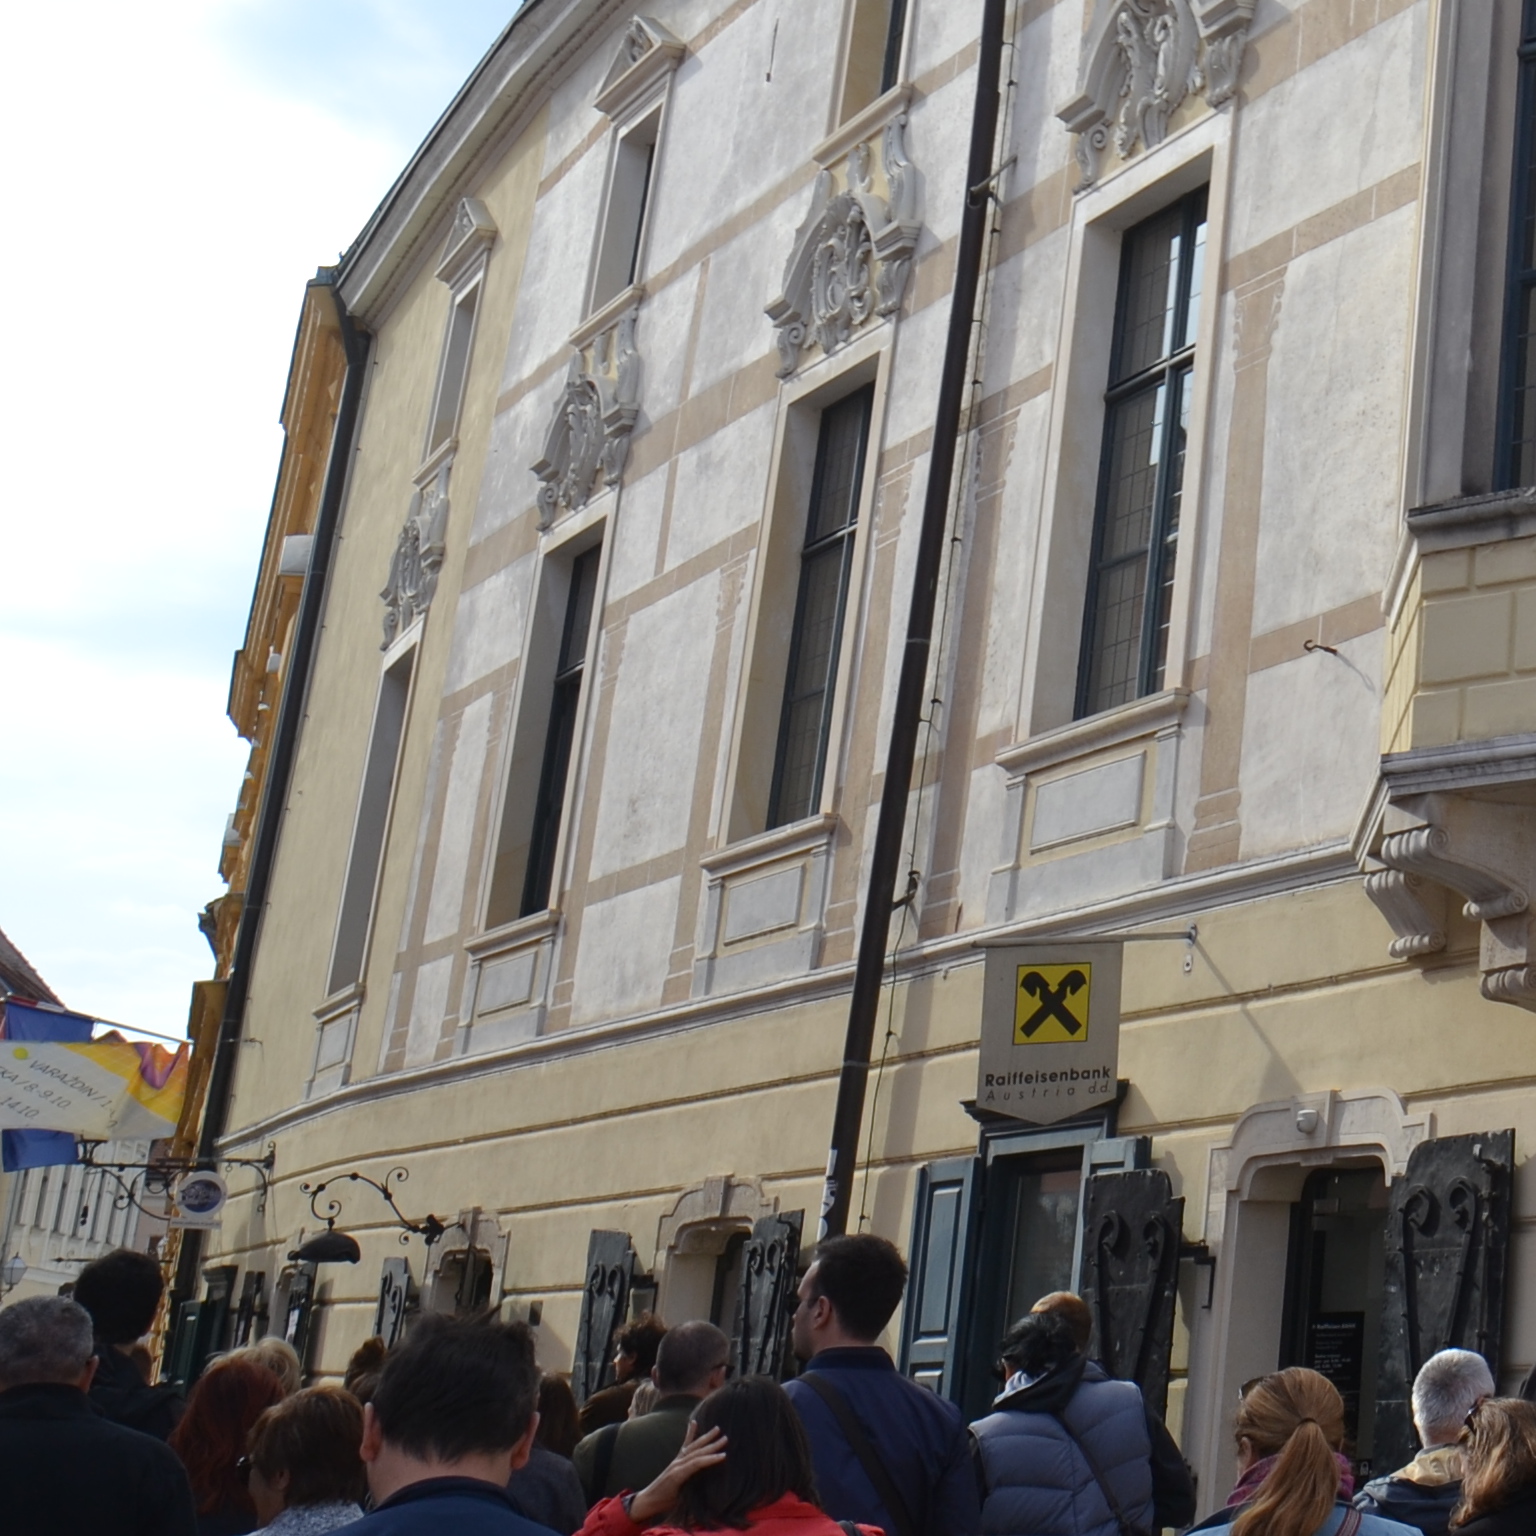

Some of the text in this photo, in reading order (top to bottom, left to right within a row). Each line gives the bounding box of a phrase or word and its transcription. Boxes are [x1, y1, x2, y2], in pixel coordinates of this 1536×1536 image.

[985, 1066, 1112, 1087] Raiffeisenbank
[985, 1081, 1111, 1102] Austria d.d.
